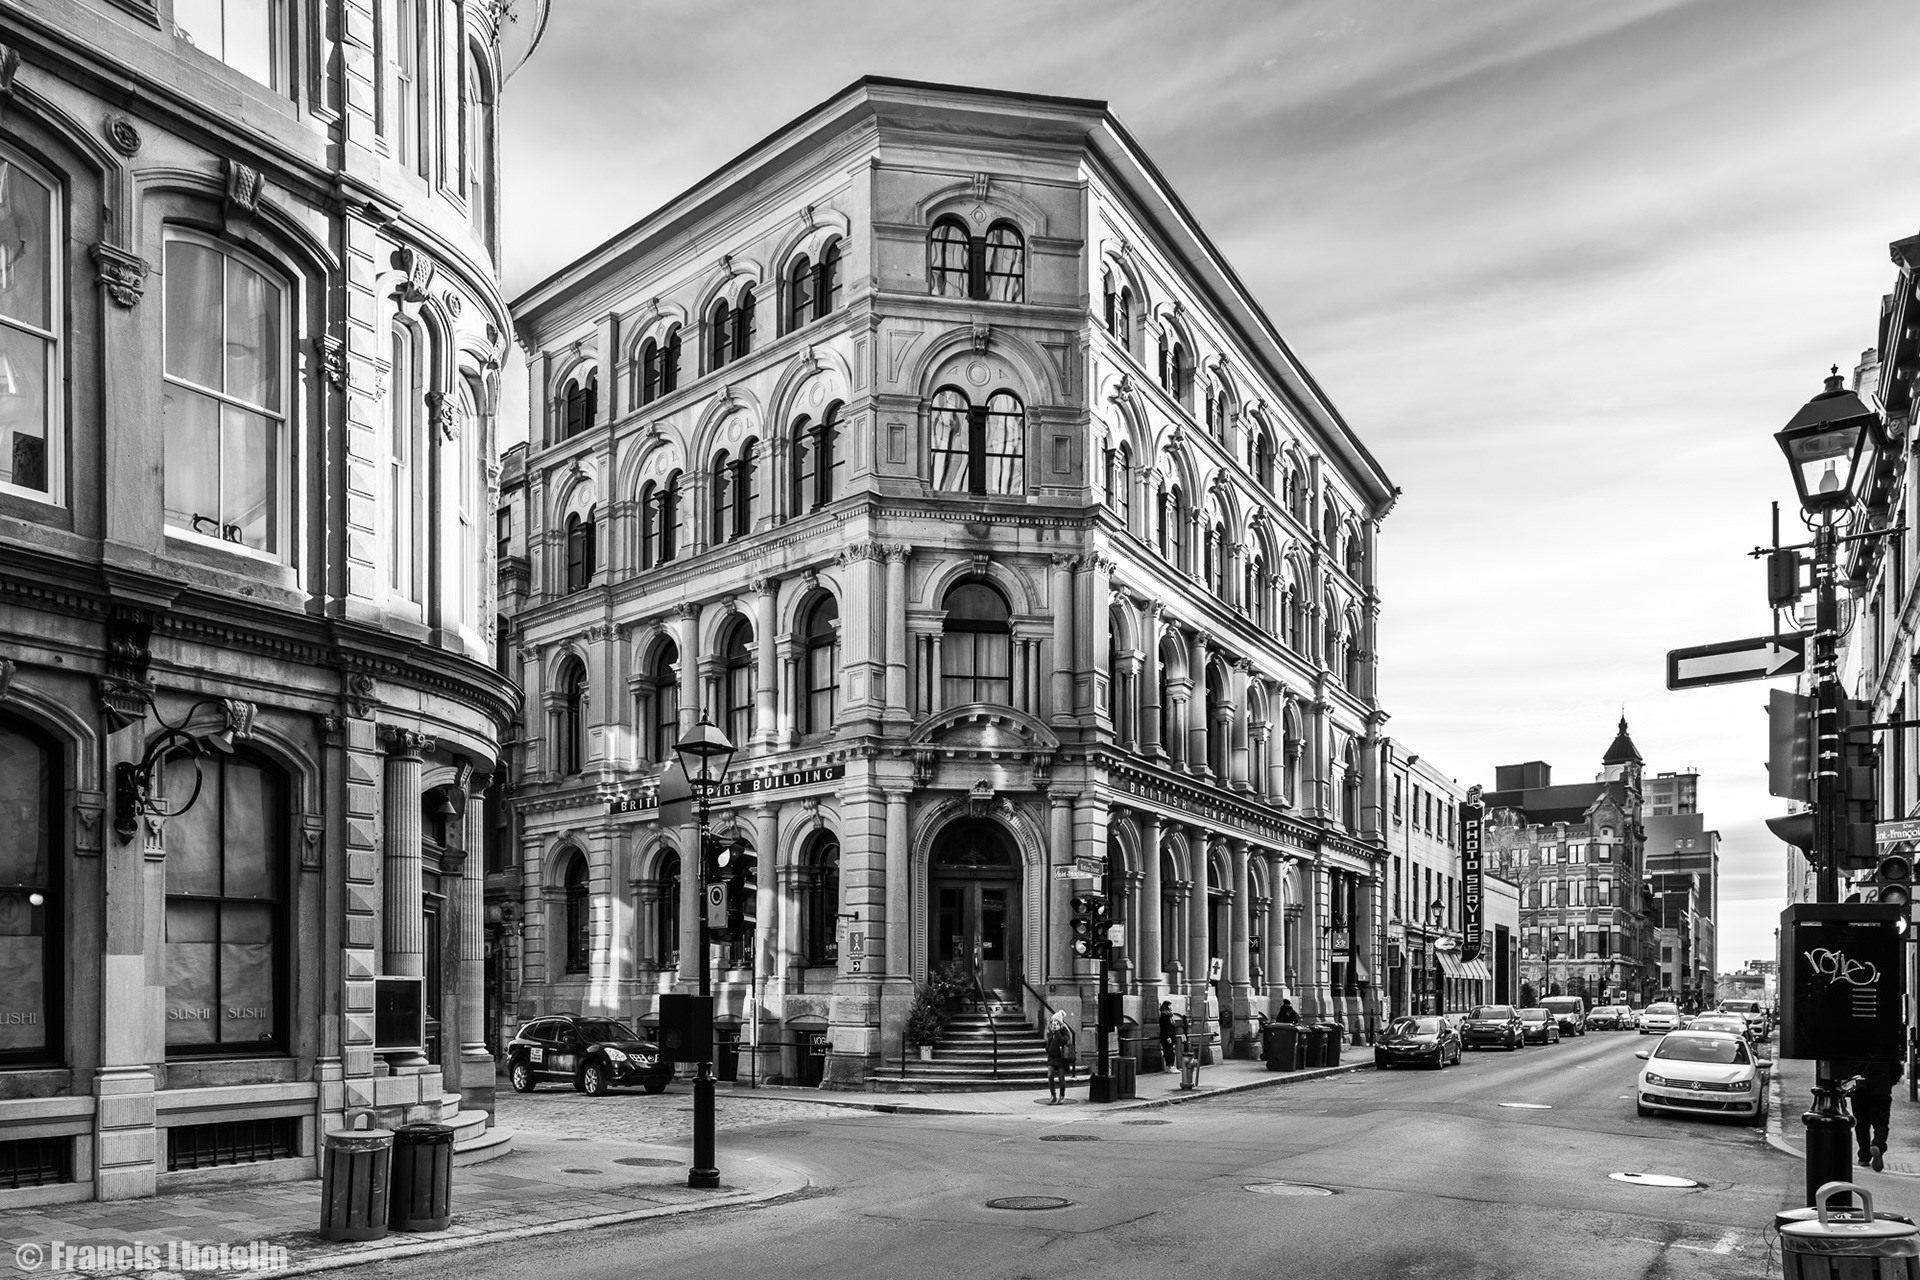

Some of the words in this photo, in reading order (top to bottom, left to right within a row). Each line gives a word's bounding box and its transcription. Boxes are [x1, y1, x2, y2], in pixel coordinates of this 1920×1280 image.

[620, 797, 658, 812] BRITI
[753, 768, 833, 792] BUILDING
[1129, 782, 1187, 810] BRITISH
[1204, 806, 1245, 829] EMPIRE
[1259, 825, 1304, 849] BUILDING
[1466, 820, 1478, 870] PHOTO
[1466, 874, 1479, 943] SERVICE
[168, 1008, 210, 1020] SUSHI
[227, 1007, 267, 1019] SUSHI
